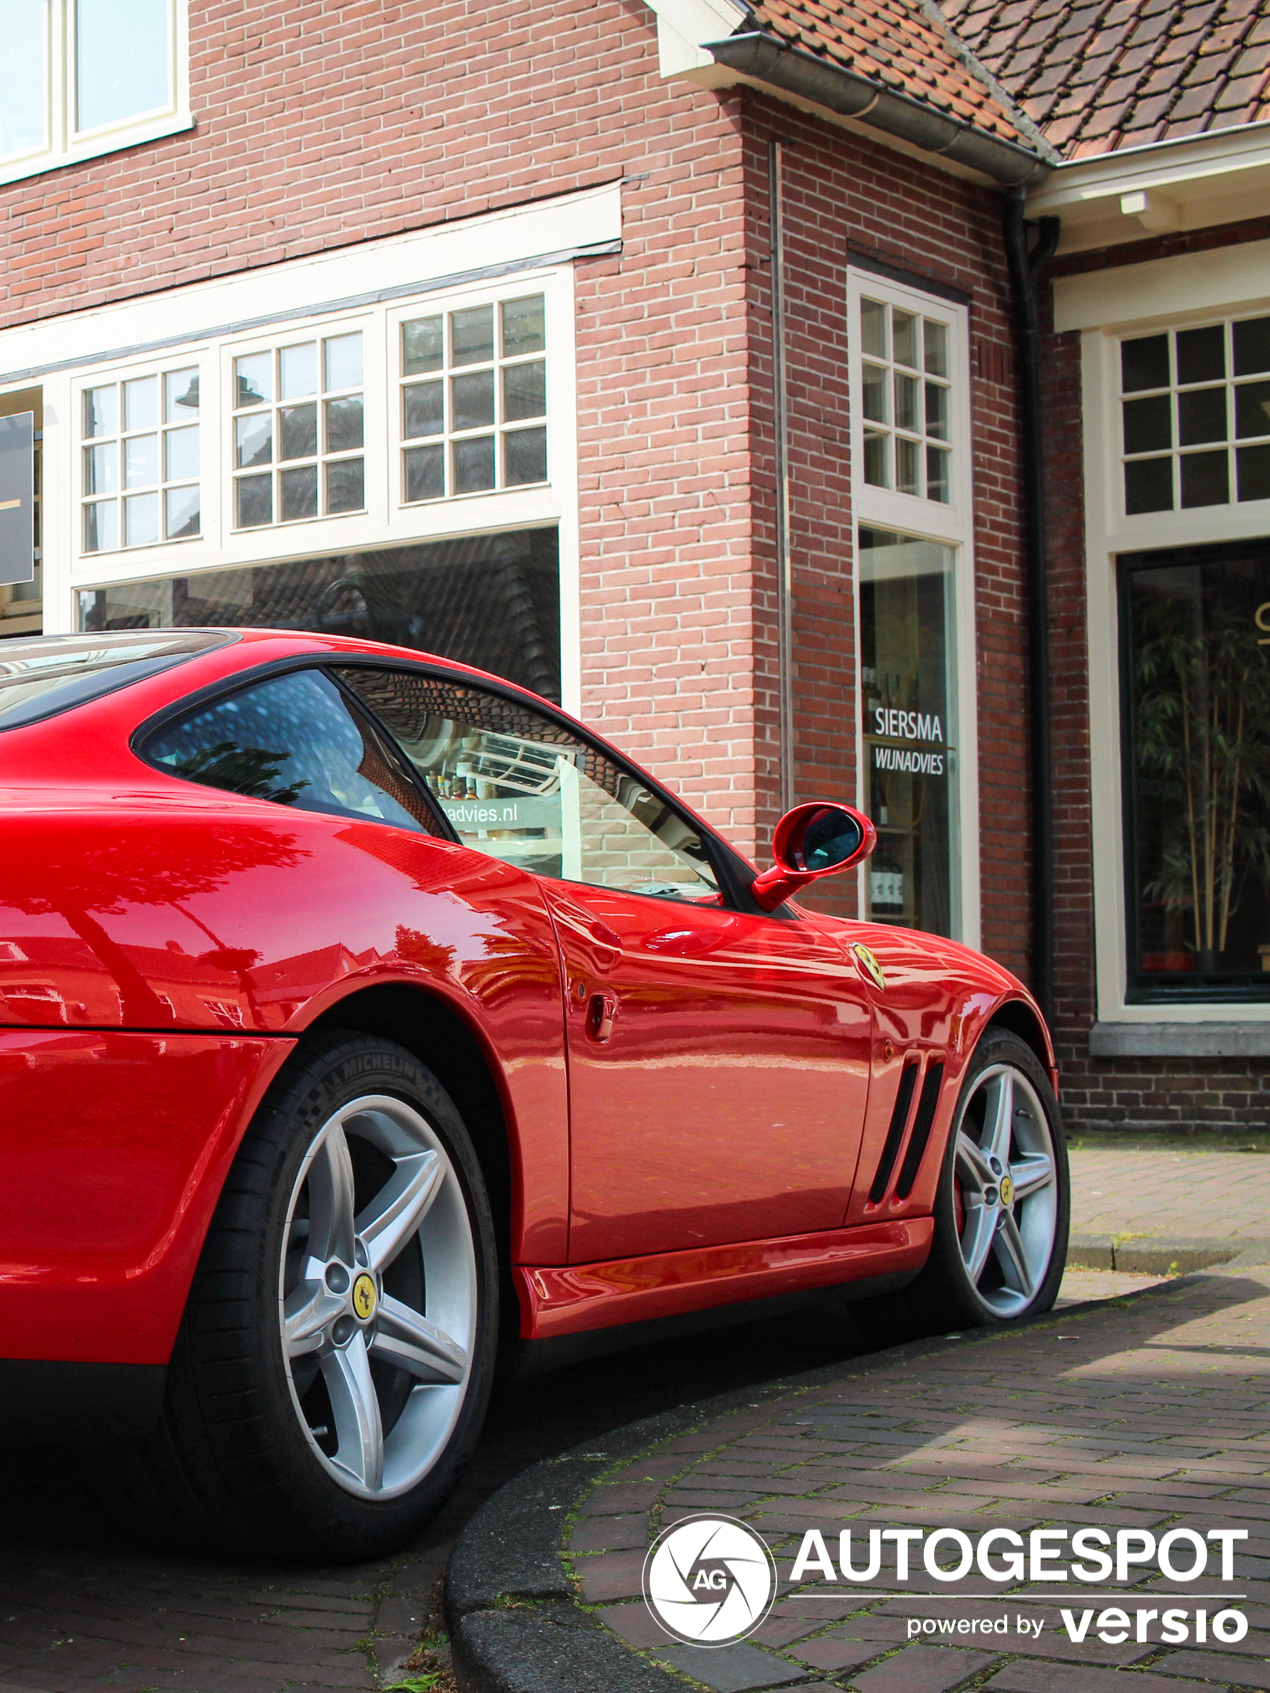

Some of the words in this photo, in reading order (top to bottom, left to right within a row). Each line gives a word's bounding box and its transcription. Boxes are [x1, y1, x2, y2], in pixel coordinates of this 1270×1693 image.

[875, 706, 943, 742] SIERSMA
[875, 747, 943, 775] WIJNADVIES
[341, 1053, 415, 1080] MICHELIN
